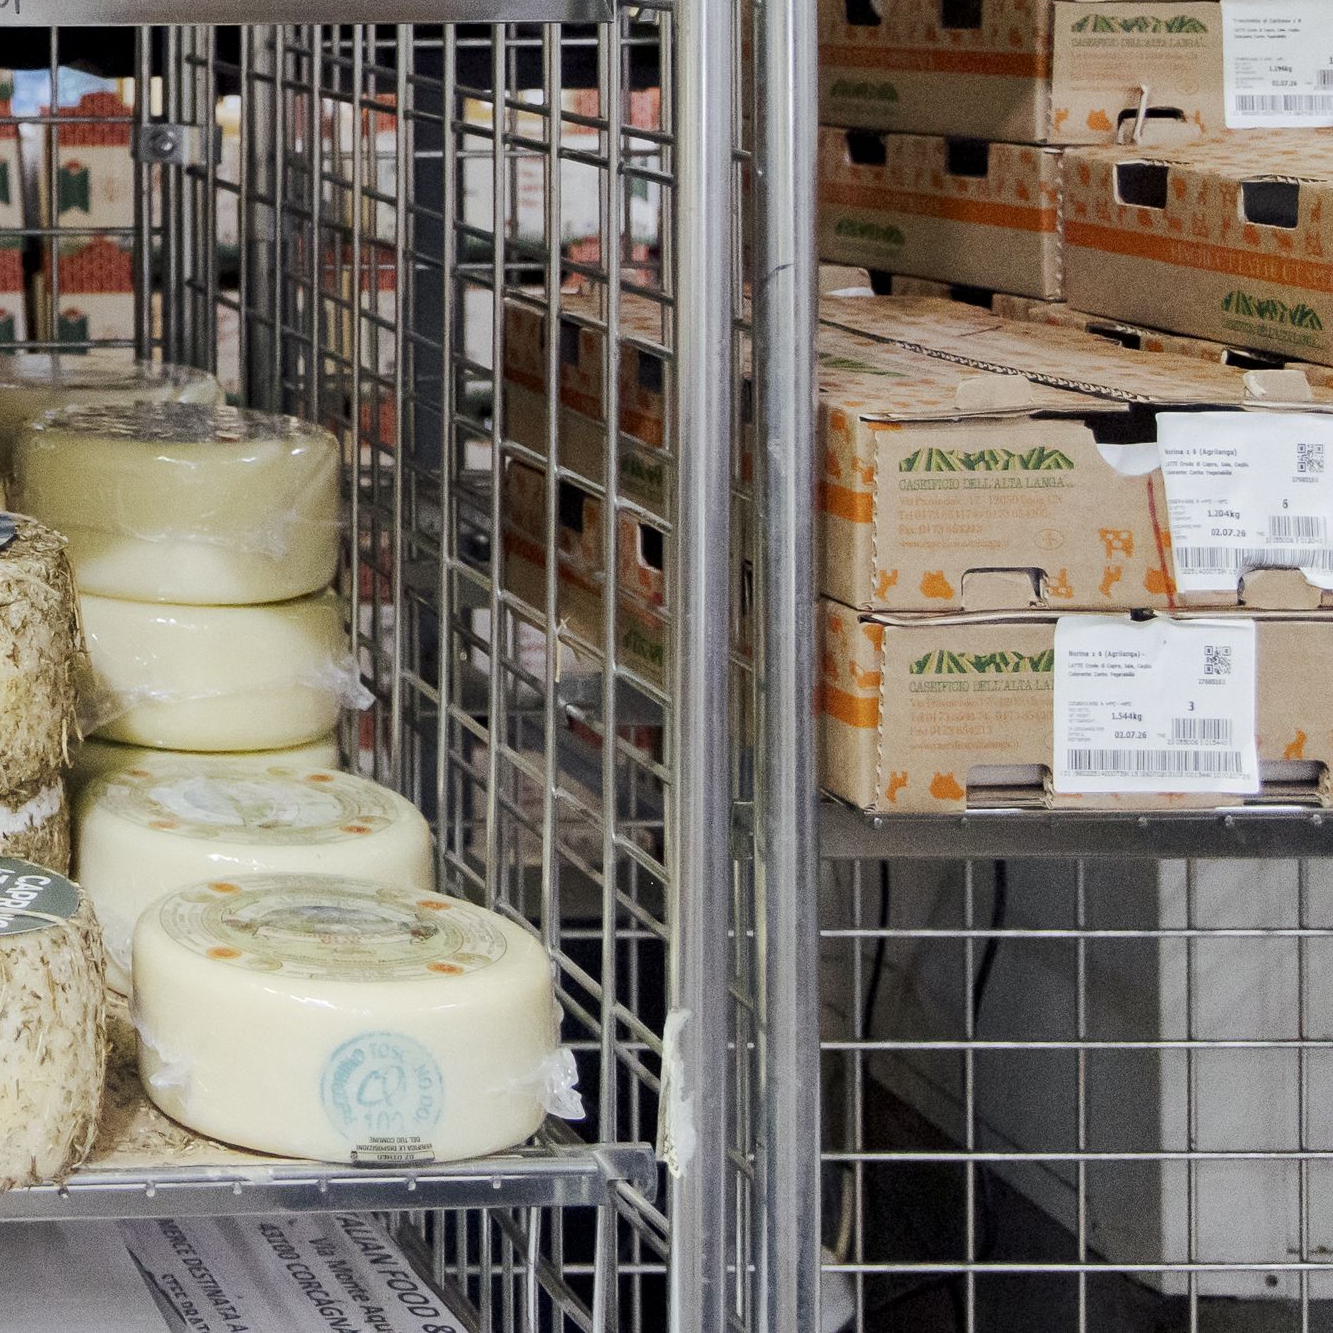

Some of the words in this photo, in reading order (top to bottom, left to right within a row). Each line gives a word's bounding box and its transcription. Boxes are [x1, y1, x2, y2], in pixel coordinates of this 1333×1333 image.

[1207, 509, 1240, 519] 1.204kg
[1211, 527, 1246, 537] 02.07.26
[1188, 701, 1195, 711] 3
[1111, 712, 1142, 722] 1.544kg
[1114, 730, 1147, 739] 02.07.26
[336, 1212, 399, 1265] ALIAN
[377, 1270, 440, 1317] FOOD
[325, 1260, 371, 1302] Monte
[286, 1263, 362, 1333] CORCAGNA
